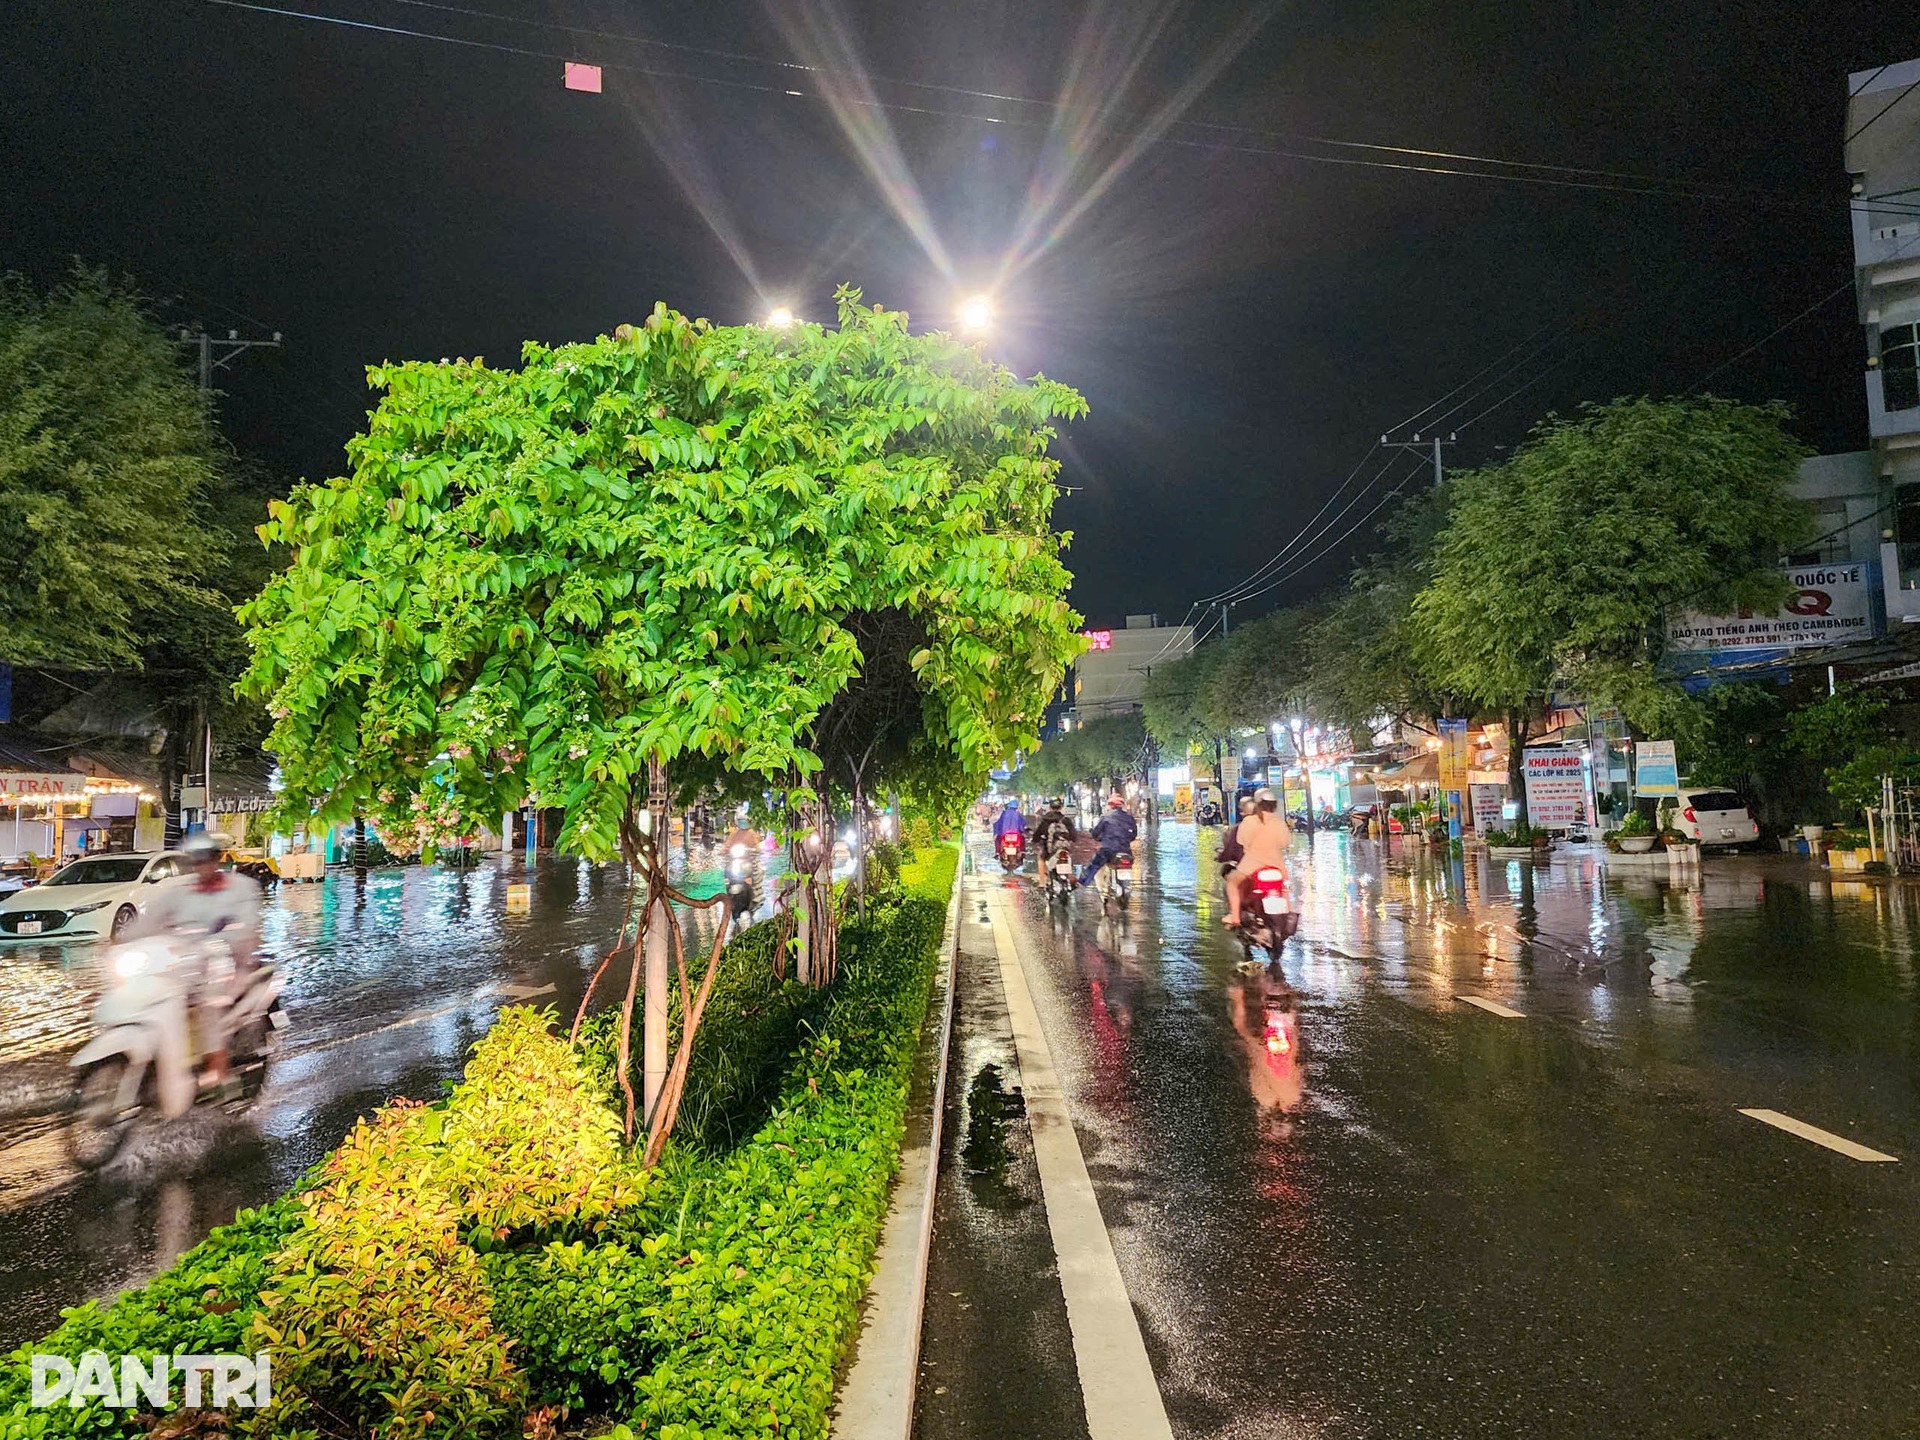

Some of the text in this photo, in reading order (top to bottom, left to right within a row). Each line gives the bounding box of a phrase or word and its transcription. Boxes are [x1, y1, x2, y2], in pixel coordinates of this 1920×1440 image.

[1795, 568, 1837, 587] QUỐC
[1840, 566, 1860, 583] TẾ
[1716, 623, 1745, 636] TIẾNG
[1748, 625, 1769, 633] ANH
[1528, 753, 1580, 767] KHAI GIẢNG
[15, 776, 64, 793] TRÂN
